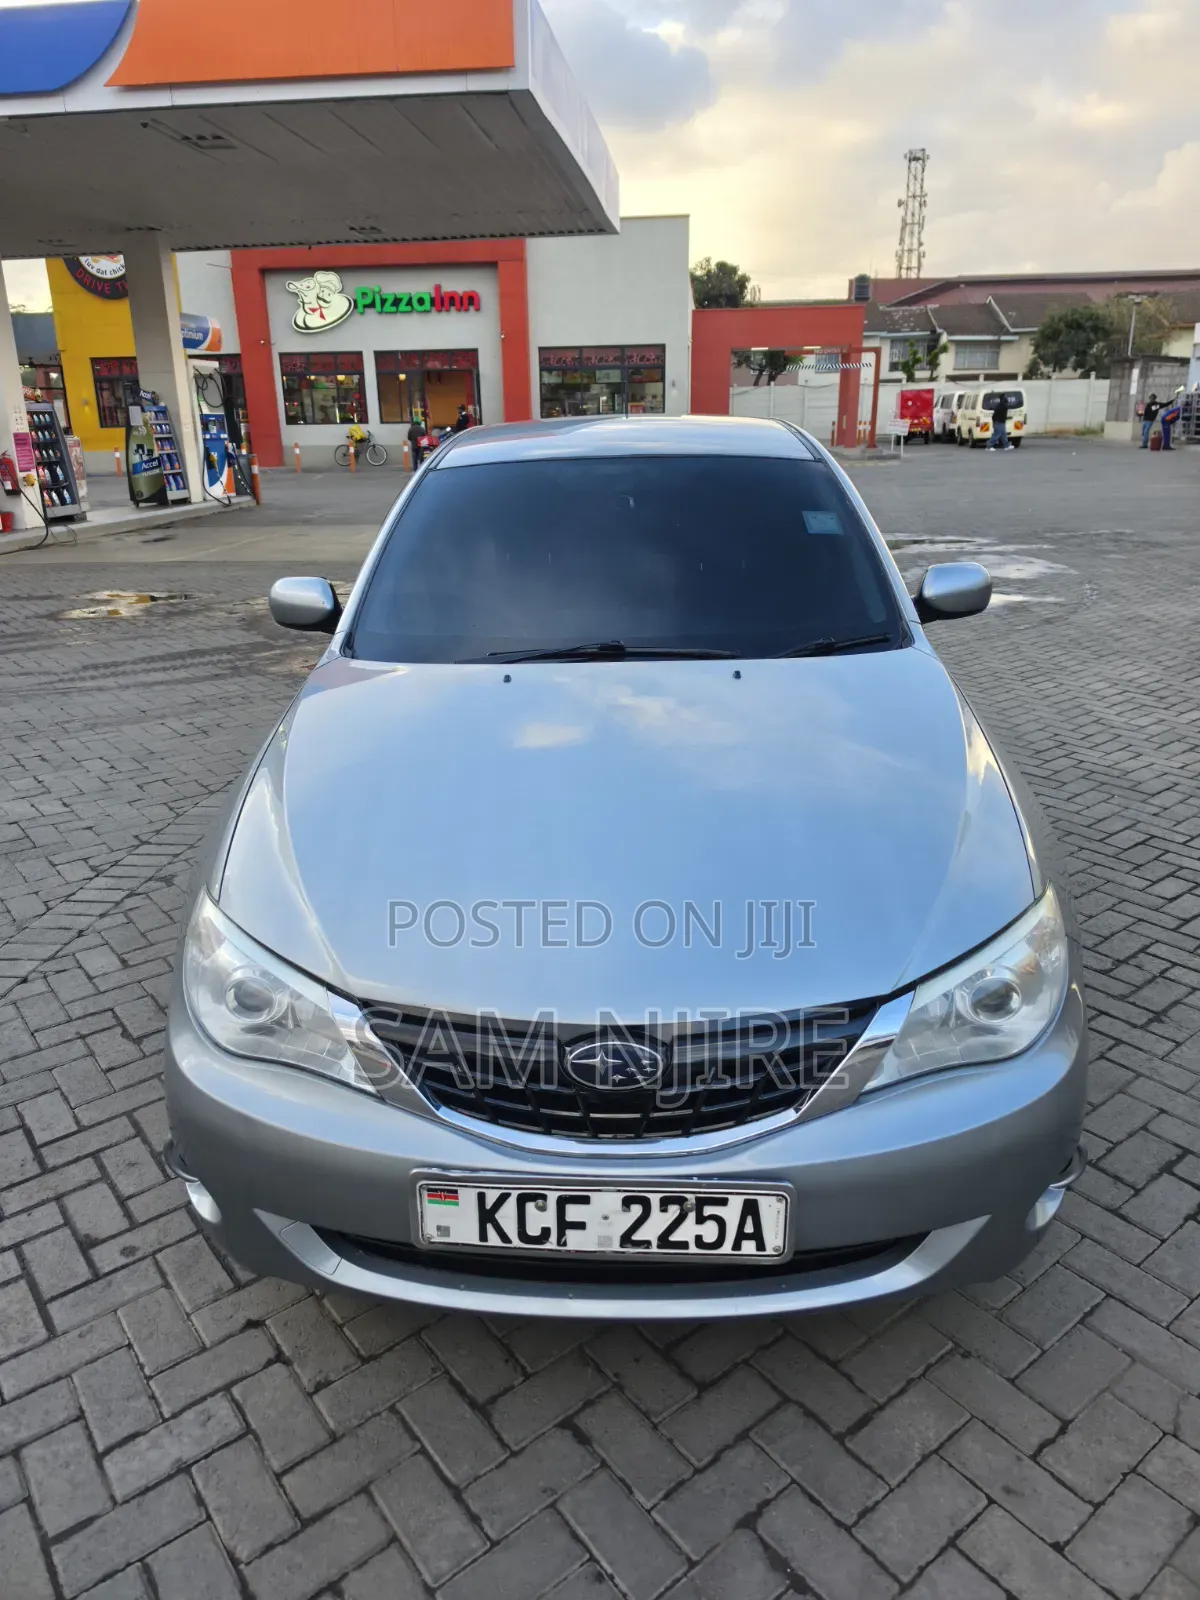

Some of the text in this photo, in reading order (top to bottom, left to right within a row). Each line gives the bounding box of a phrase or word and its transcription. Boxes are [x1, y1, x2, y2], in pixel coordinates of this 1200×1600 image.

[96, 267, 108, 276] dat
[109, 263, 126, 276] chick
[75, 267, 112, 295] DRIVE
[141, 459, 159, 470] Accel
[476, 1191, 591, 1248] KCF
[618, 1194, 767, 1254] 225A
